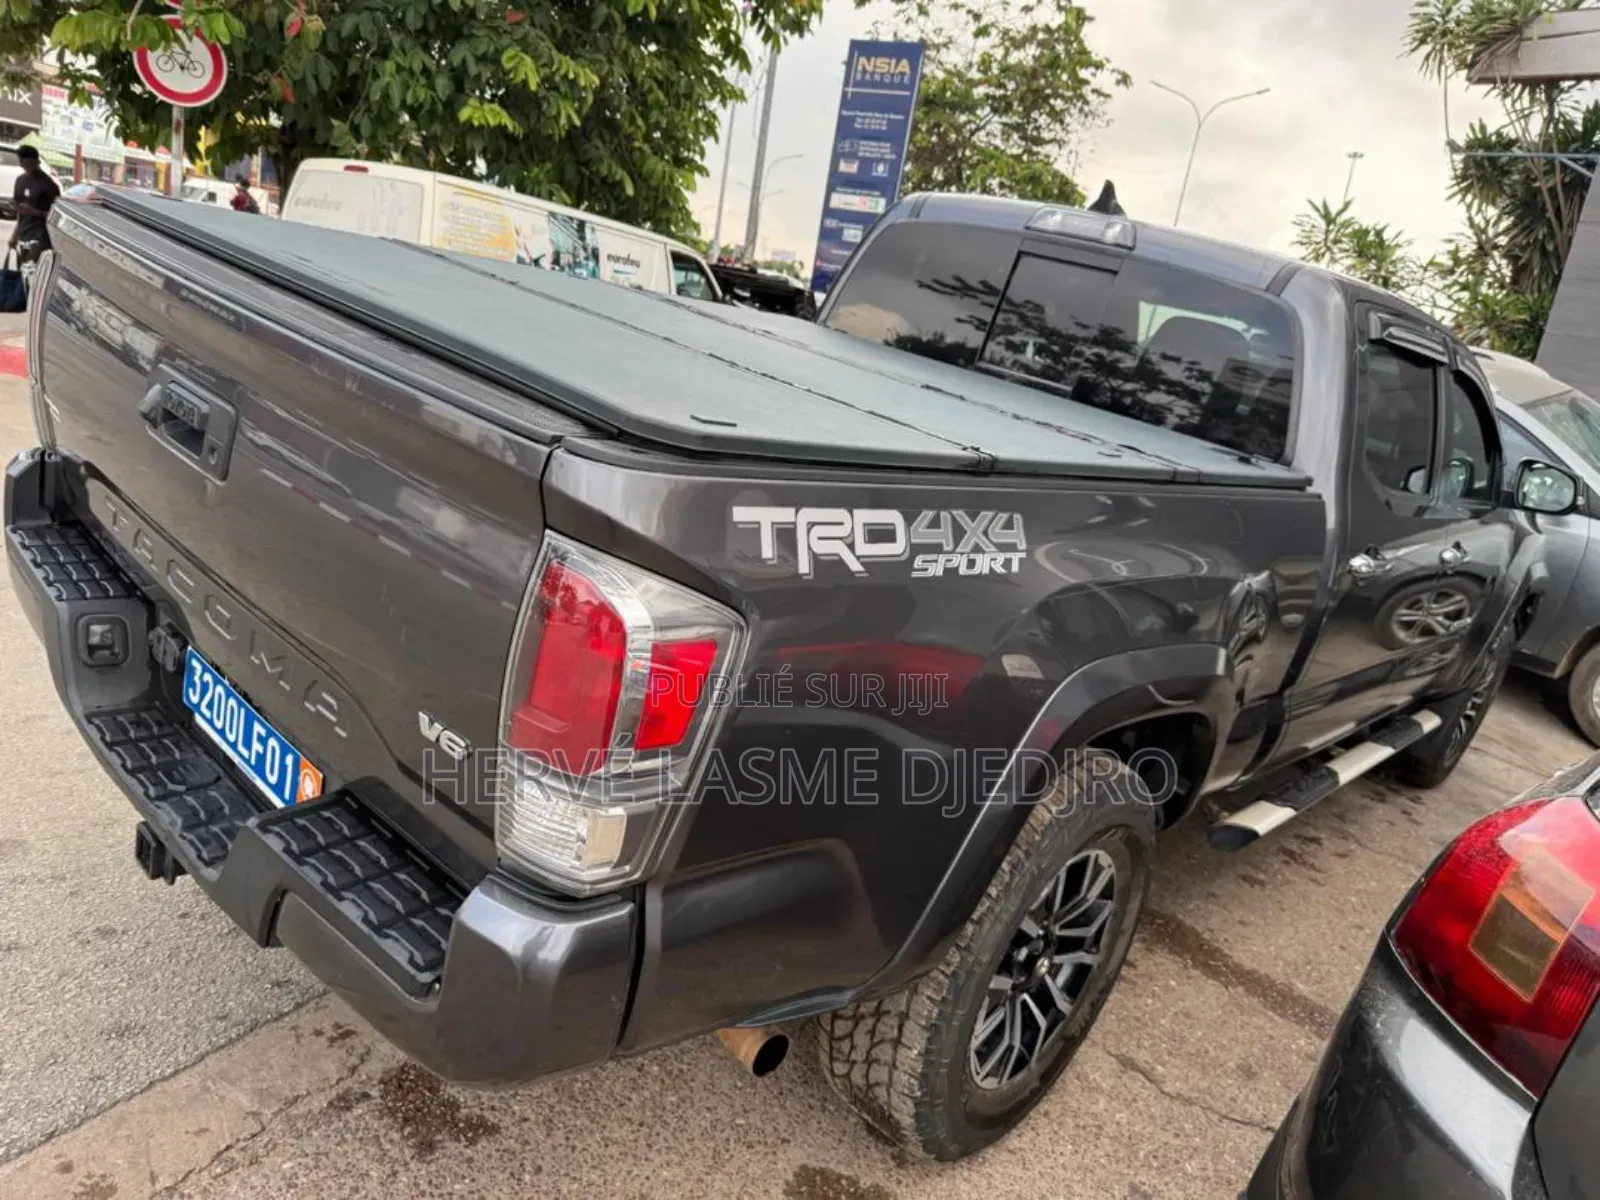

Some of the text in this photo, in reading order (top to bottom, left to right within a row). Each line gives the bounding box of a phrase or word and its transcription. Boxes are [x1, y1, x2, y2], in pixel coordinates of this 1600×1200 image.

[855, 72, 910, 85] BANQUE
[857, 56, 911, 74] NSIA
[732, 505, 909, 580] TRD
[911, 551, 1028, 578] SPORT
[105, 496, 349, 739] TACOMA
[187, 657, 294, 801] 3200LF01
[417, 709, 474, 763] V6
